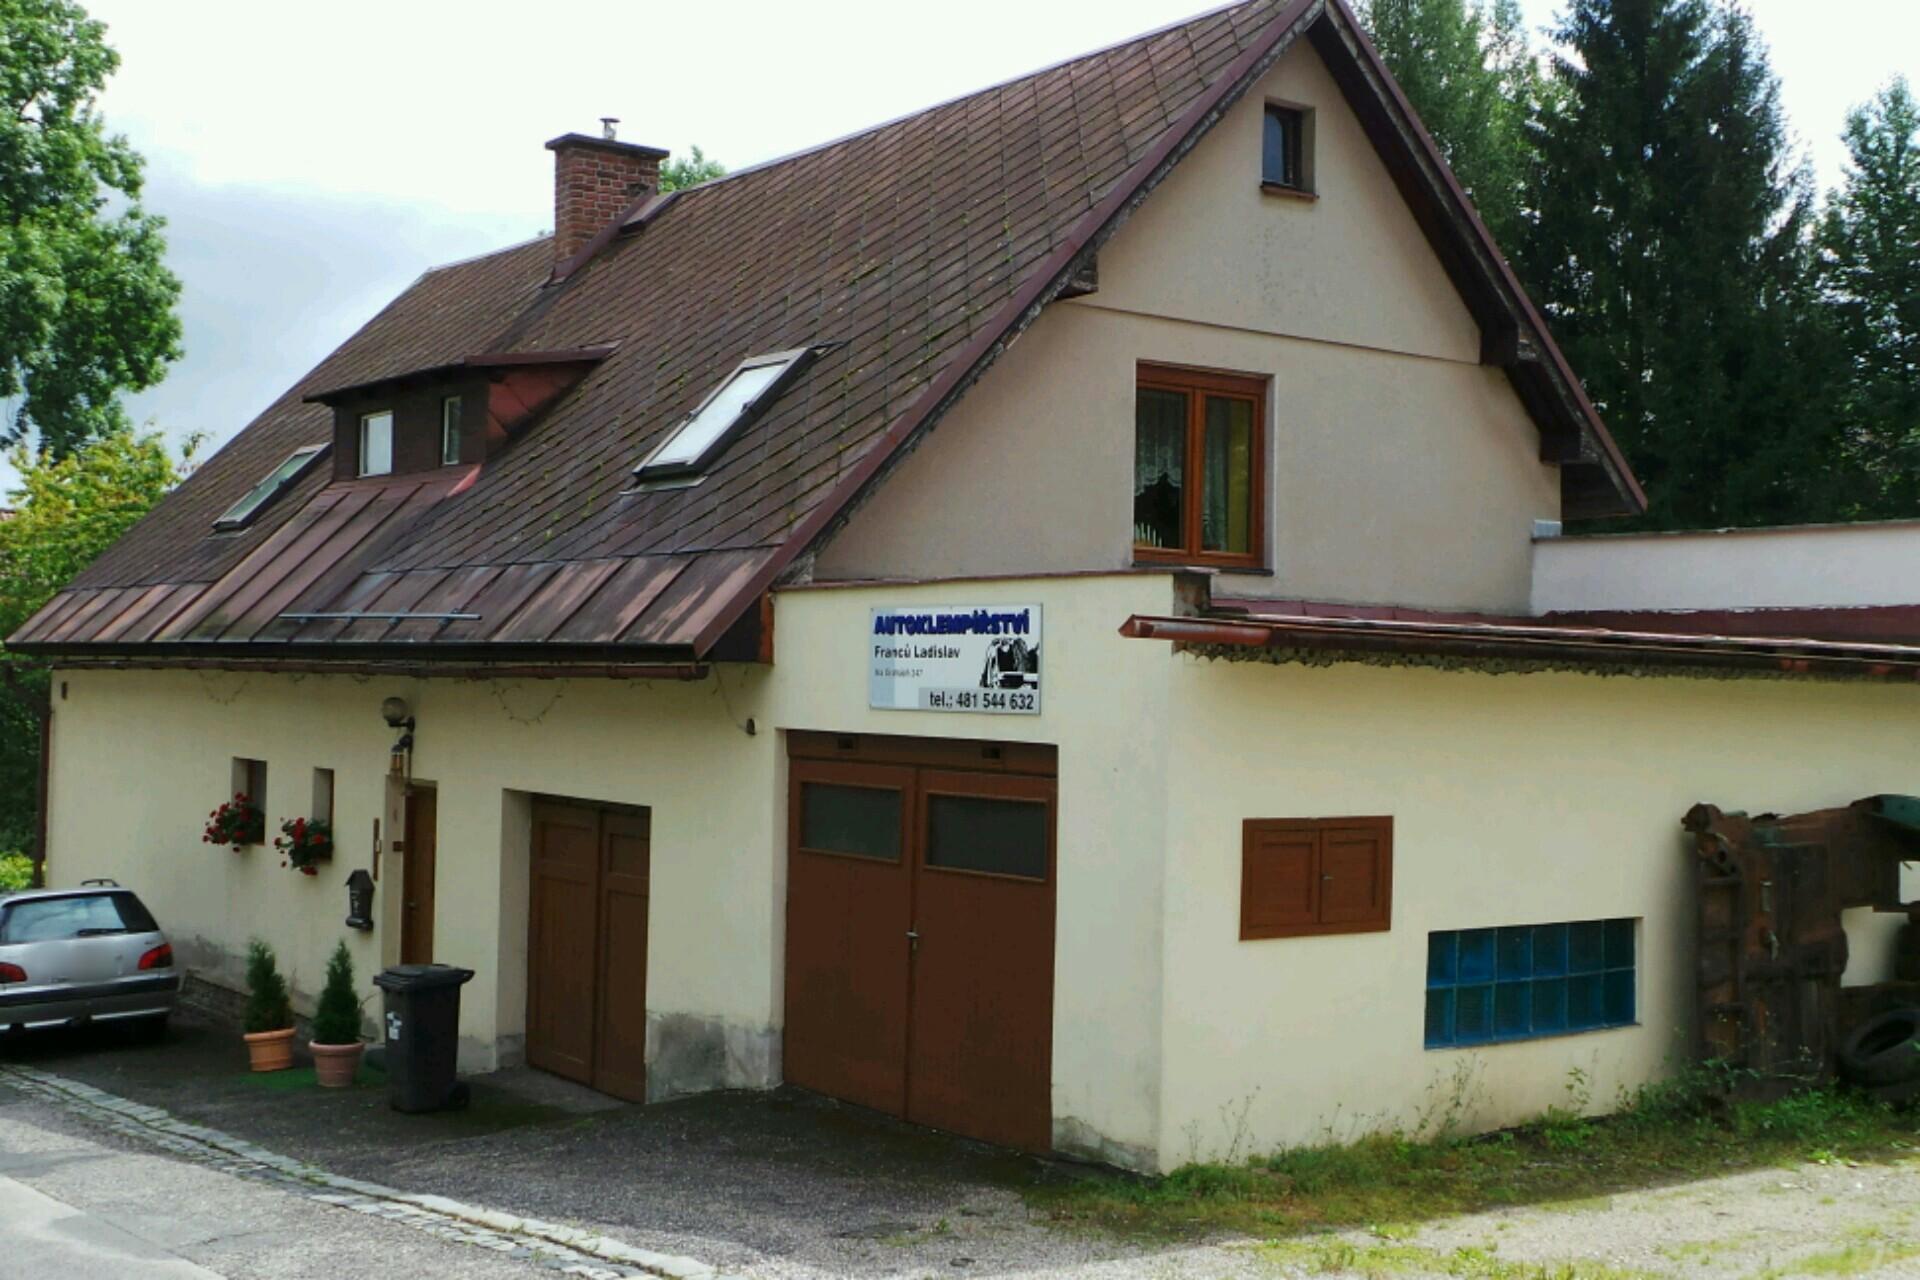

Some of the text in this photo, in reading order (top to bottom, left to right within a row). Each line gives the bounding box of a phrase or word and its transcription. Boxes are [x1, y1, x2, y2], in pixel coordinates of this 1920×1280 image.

[874, 608, 1030, 635] AUTOKLEMPÍŘSTVÍ
[874, 643, 960, 658] Franců Ladislav
[929, 691, 1034, 710] tel.: 481 544 632
